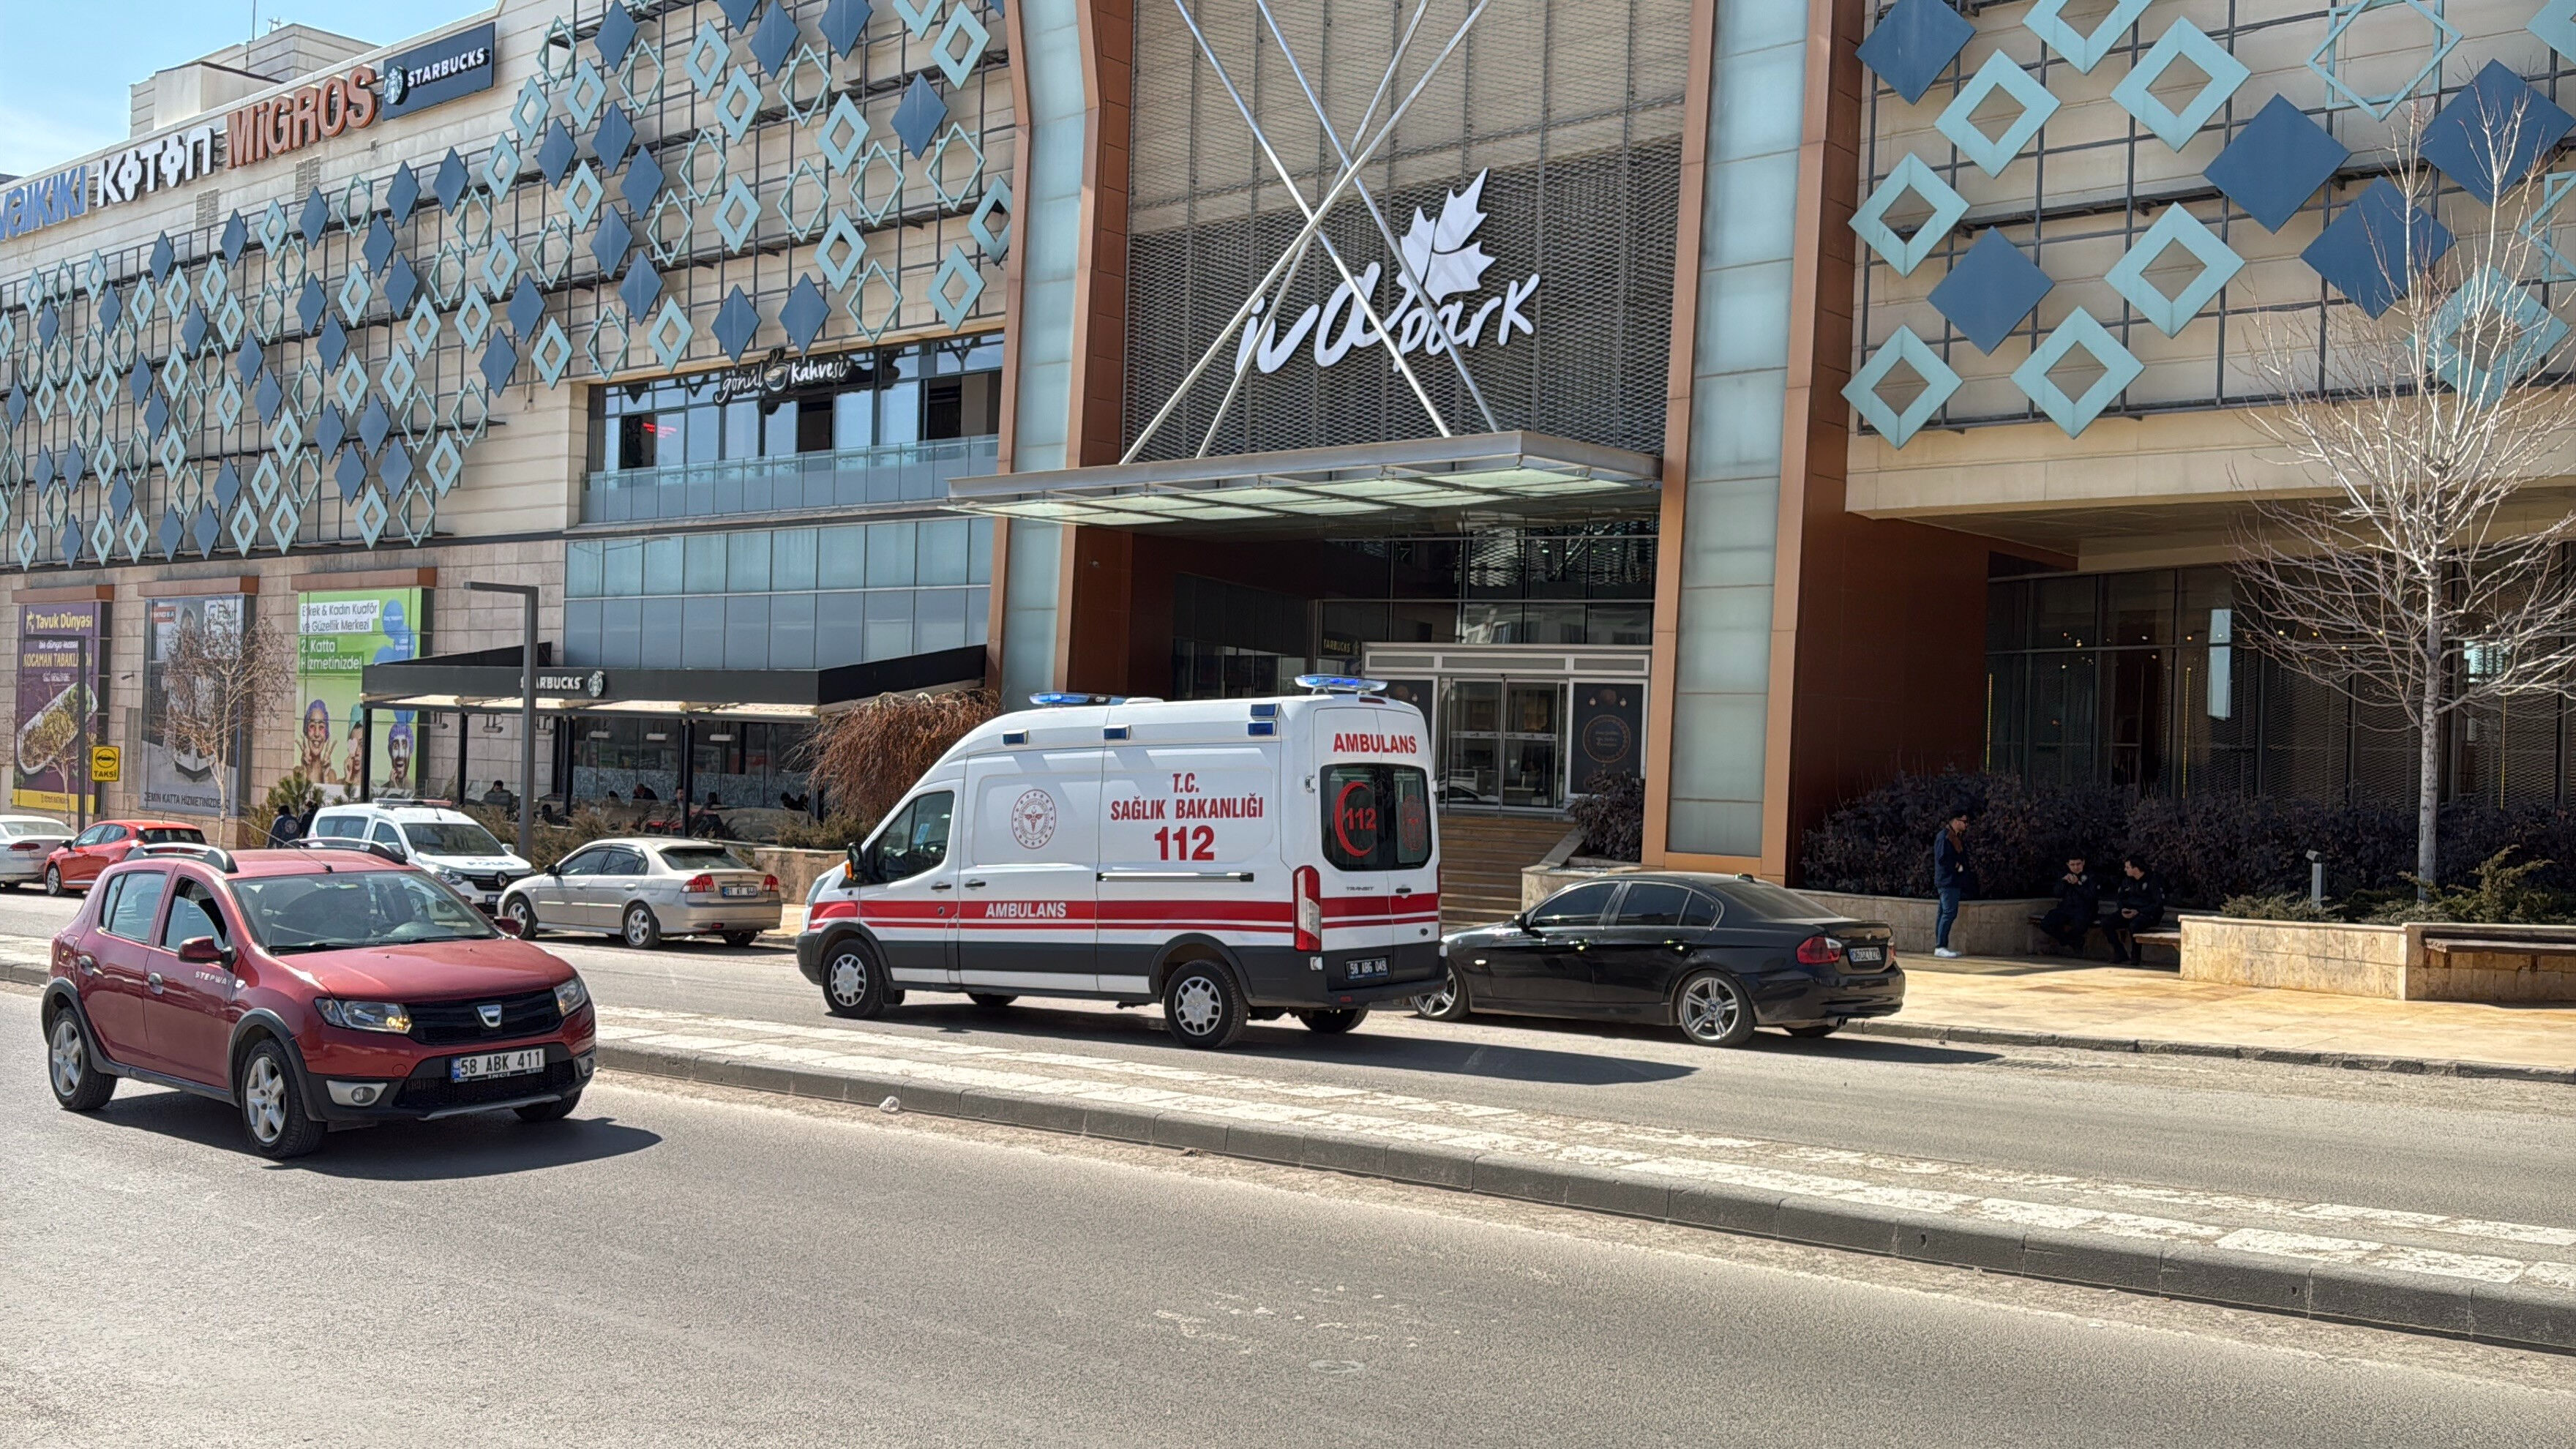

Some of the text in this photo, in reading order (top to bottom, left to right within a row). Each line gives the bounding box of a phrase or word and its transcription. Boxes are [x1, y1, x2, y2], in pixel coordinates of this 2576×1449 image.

[407, 48, 489, 87] STARBUCKS
[791, 354, 851, 384] kahvesi
[322, 604, 327, 615] &
[329, 604, 351, 615] Kadın
[353, 602, 378, 615] Kuaför
[36, 612, 93, 631] Tavuk Dünyası
[312, 619, 339, 632] Güzellik
[341, 618, 370, 631] Merkezi
[310, 639, 335, 653] Katta
[23, 653, 53, 667] KOCAMAN
[1333, 733, 1418, 754] AMBULANS
[1172, 772, 1199, 793] T.C.
[162, 793, 180, 804] KATTA
[1110, 792, 1264, 820] SAĞLIK BAKANLIĞI
[1345, 807, 1377, 831] 112
[1154, 825, 1215, 861] 112
[985, 902, 1067, 918] AMBULANS
[195, 970, 233, 986] STEPWAY
[460, 1051, 540, 1075] 58 ABK 411
